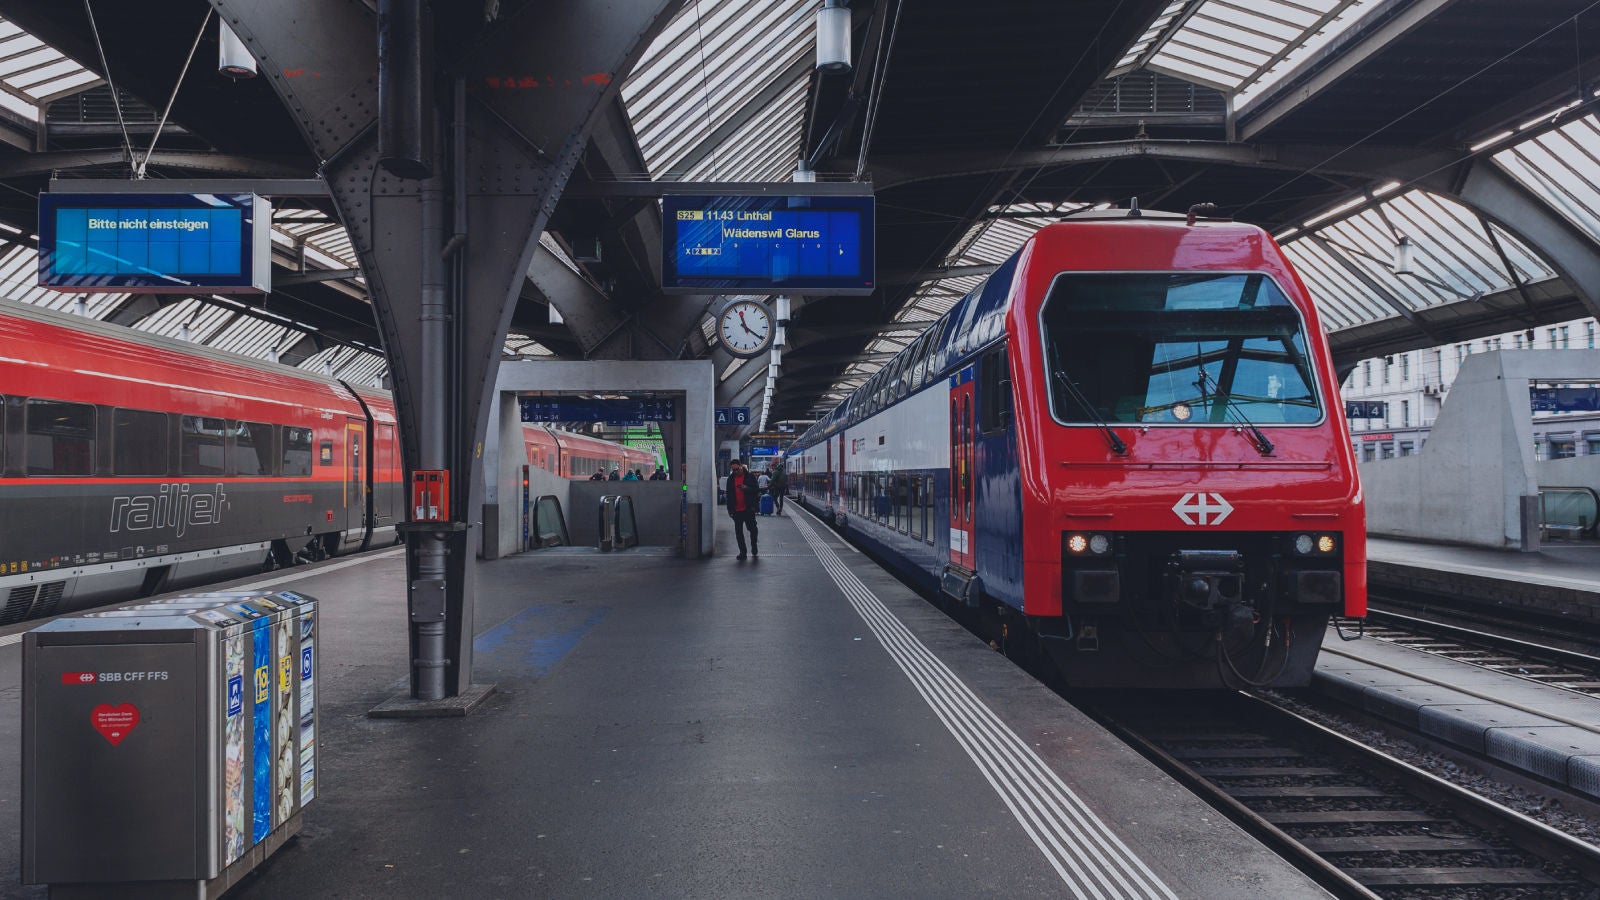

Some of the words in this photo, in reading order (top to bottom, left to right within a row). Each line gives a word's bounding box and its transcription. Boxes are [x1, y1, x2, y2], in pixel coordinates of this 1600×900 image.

[678, 211, 695, 220] S25
[706, 211, 734, 221] 11.43
[737, 210, 772, 221] Linthal
[88, 218, 118, 230] Bitte
[118, 218, 148, 230] nicht
[149, 218, 209, 232] einsteigen
[723, 228, 782, 239] Wädenswil
[785, 228, 820, 239] Glarus
[1352, 406, 1360, 416] A
[1371, 406, 1380, 416] 4
[718, 412, 726, 422] A
[737, 412, 745, 422] 6
[353, 444, 359, 456] 2
[109, 482, 227, 538] railjet
[98, 672, 122, 682] SBB
[123, 672, 146, 681] CFF
[147, 671, 169, 681] FFS
